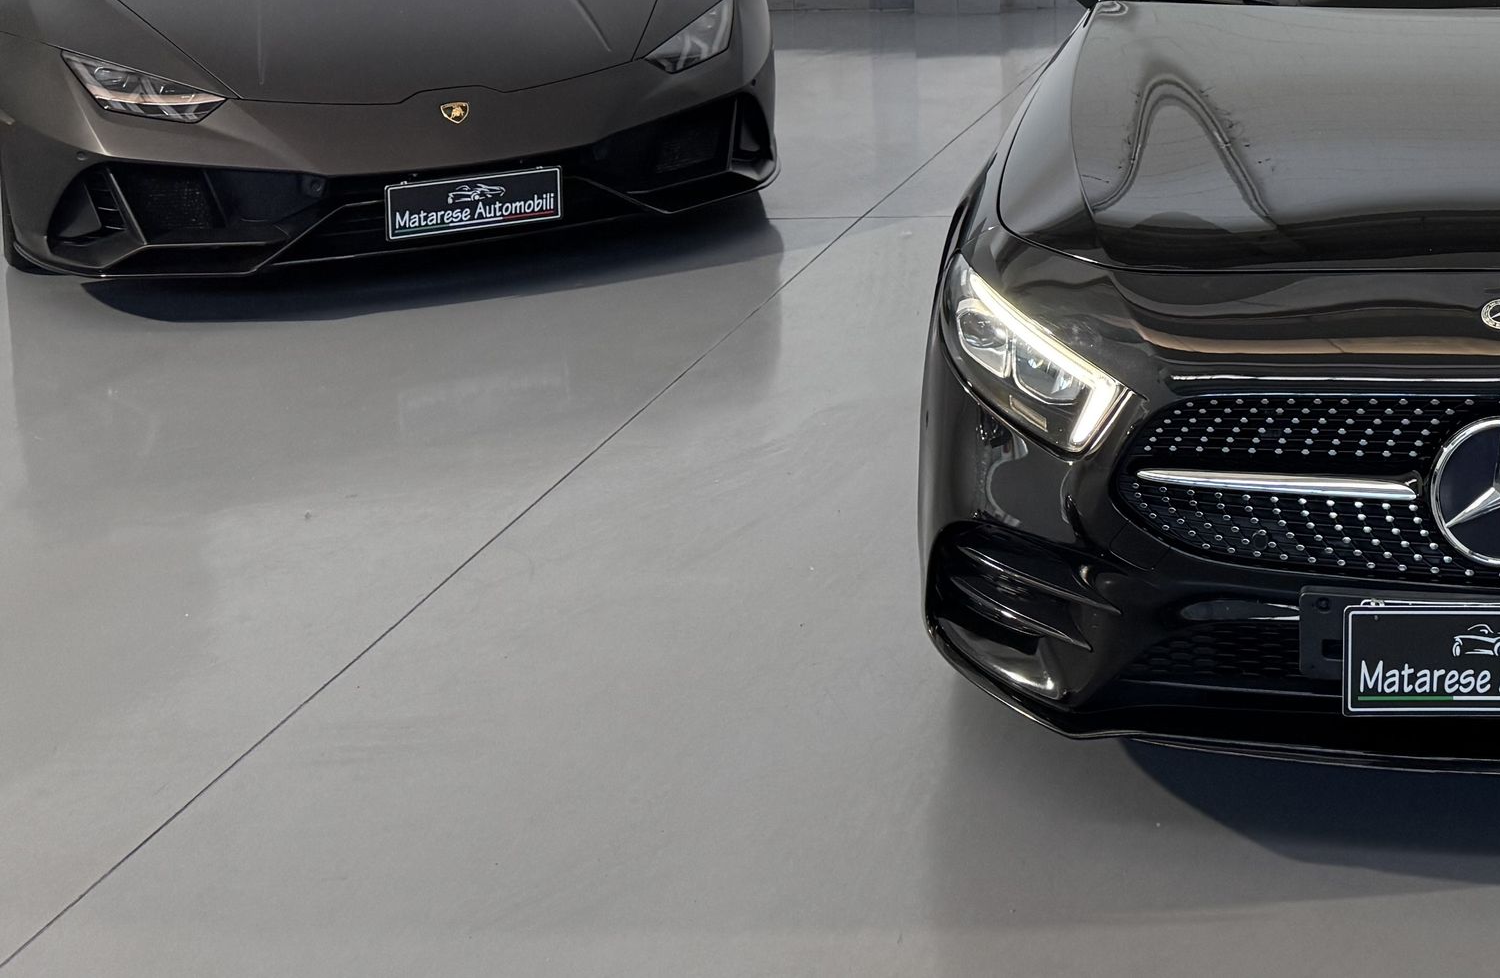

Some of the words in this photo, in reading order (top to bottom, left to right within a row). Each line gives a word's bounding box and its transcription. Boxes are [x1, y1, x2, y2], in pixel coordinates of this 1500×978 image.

[395, 207, 471, 229] Matarese
[474, 192, 555, 219] Automobili
[1359, 659, 1491, 694] Matarese
